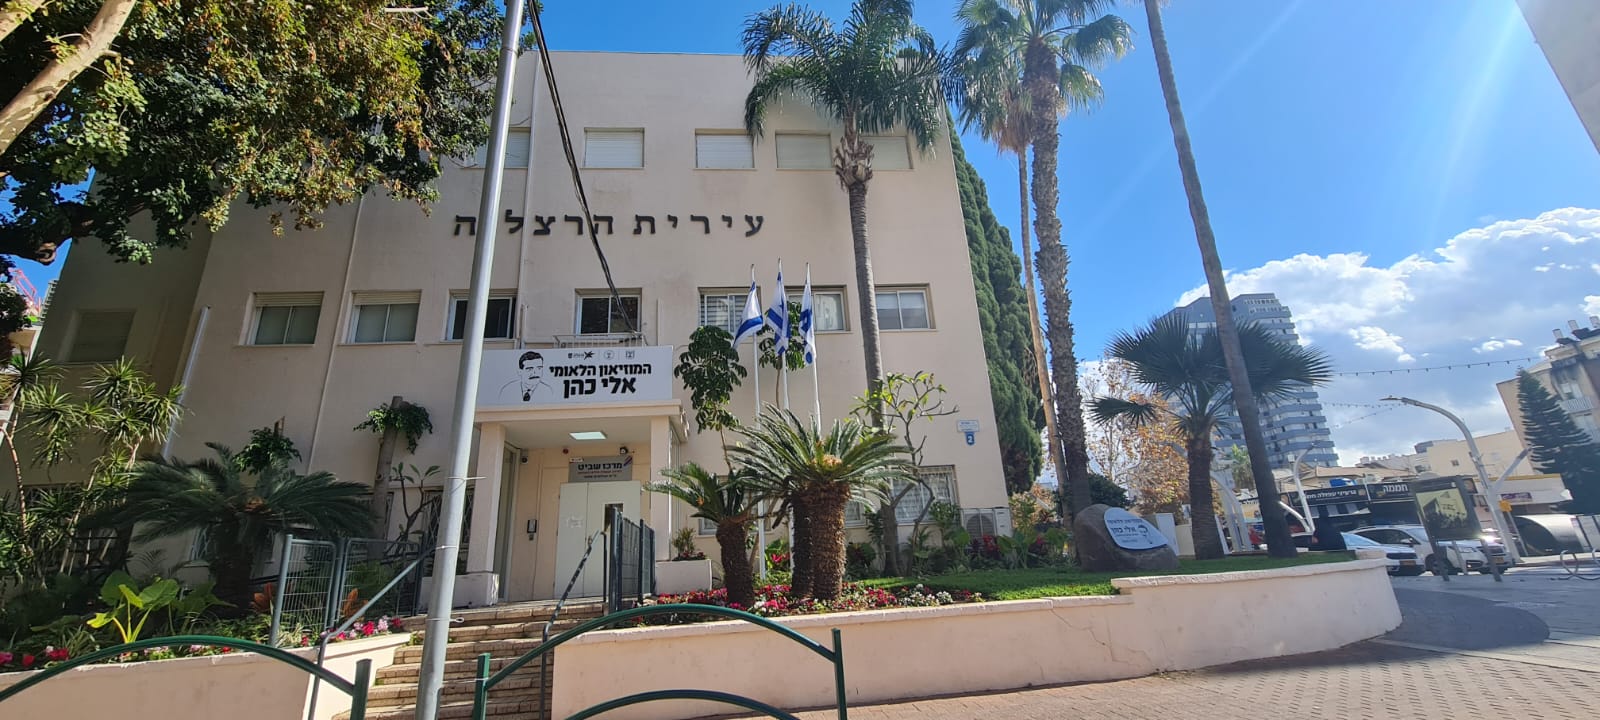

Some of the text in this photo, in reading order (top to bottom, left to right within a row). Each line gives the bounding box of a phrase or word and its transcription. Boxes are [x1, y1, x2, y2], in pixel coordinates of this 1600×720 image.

[454, 209, 763, 237] עירית הרצלה
[549, 363, 652, 378] המוזיאון הלאומי
[563, 375, 636, 399] אלי כהן
[967, 435, 973, 443] 2
[1382, 483, 1409, 493] חממה
